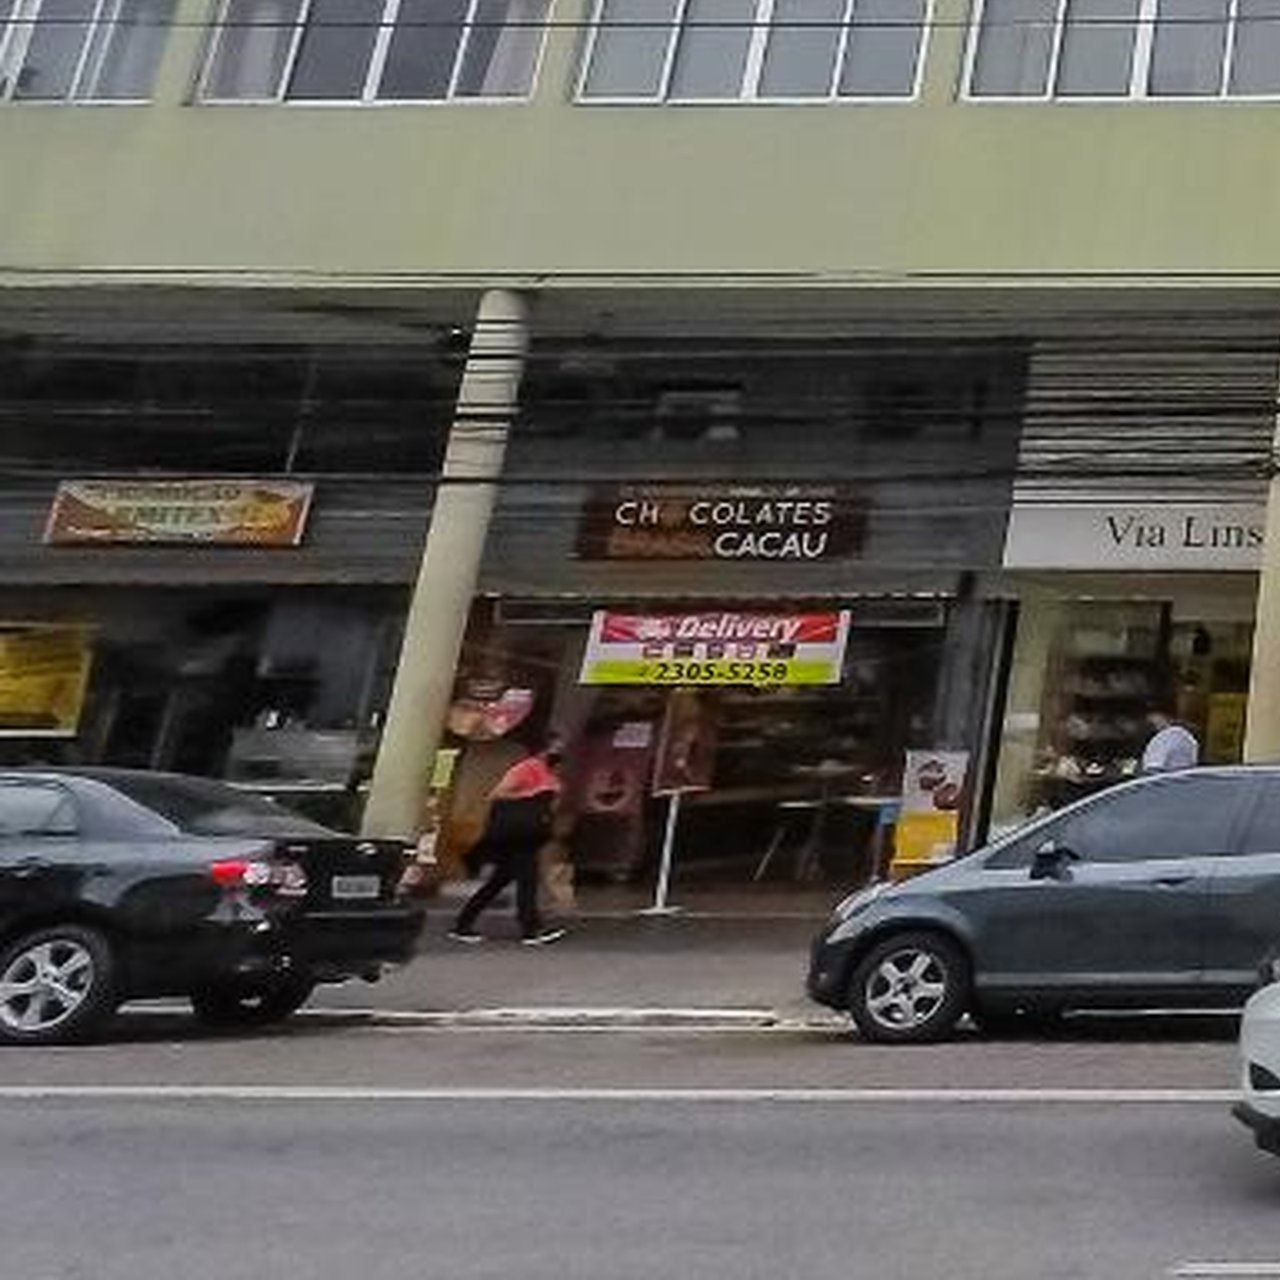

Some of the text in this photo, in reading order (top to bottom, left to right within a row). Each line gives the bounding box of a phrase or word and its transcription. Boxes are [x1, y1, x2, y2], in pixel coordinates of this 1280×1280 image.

[713, 532, 828, 558] CACAU
[1107, 515, 1264, 548] Via Lins
[675, 612, 801, 643] Delivery
